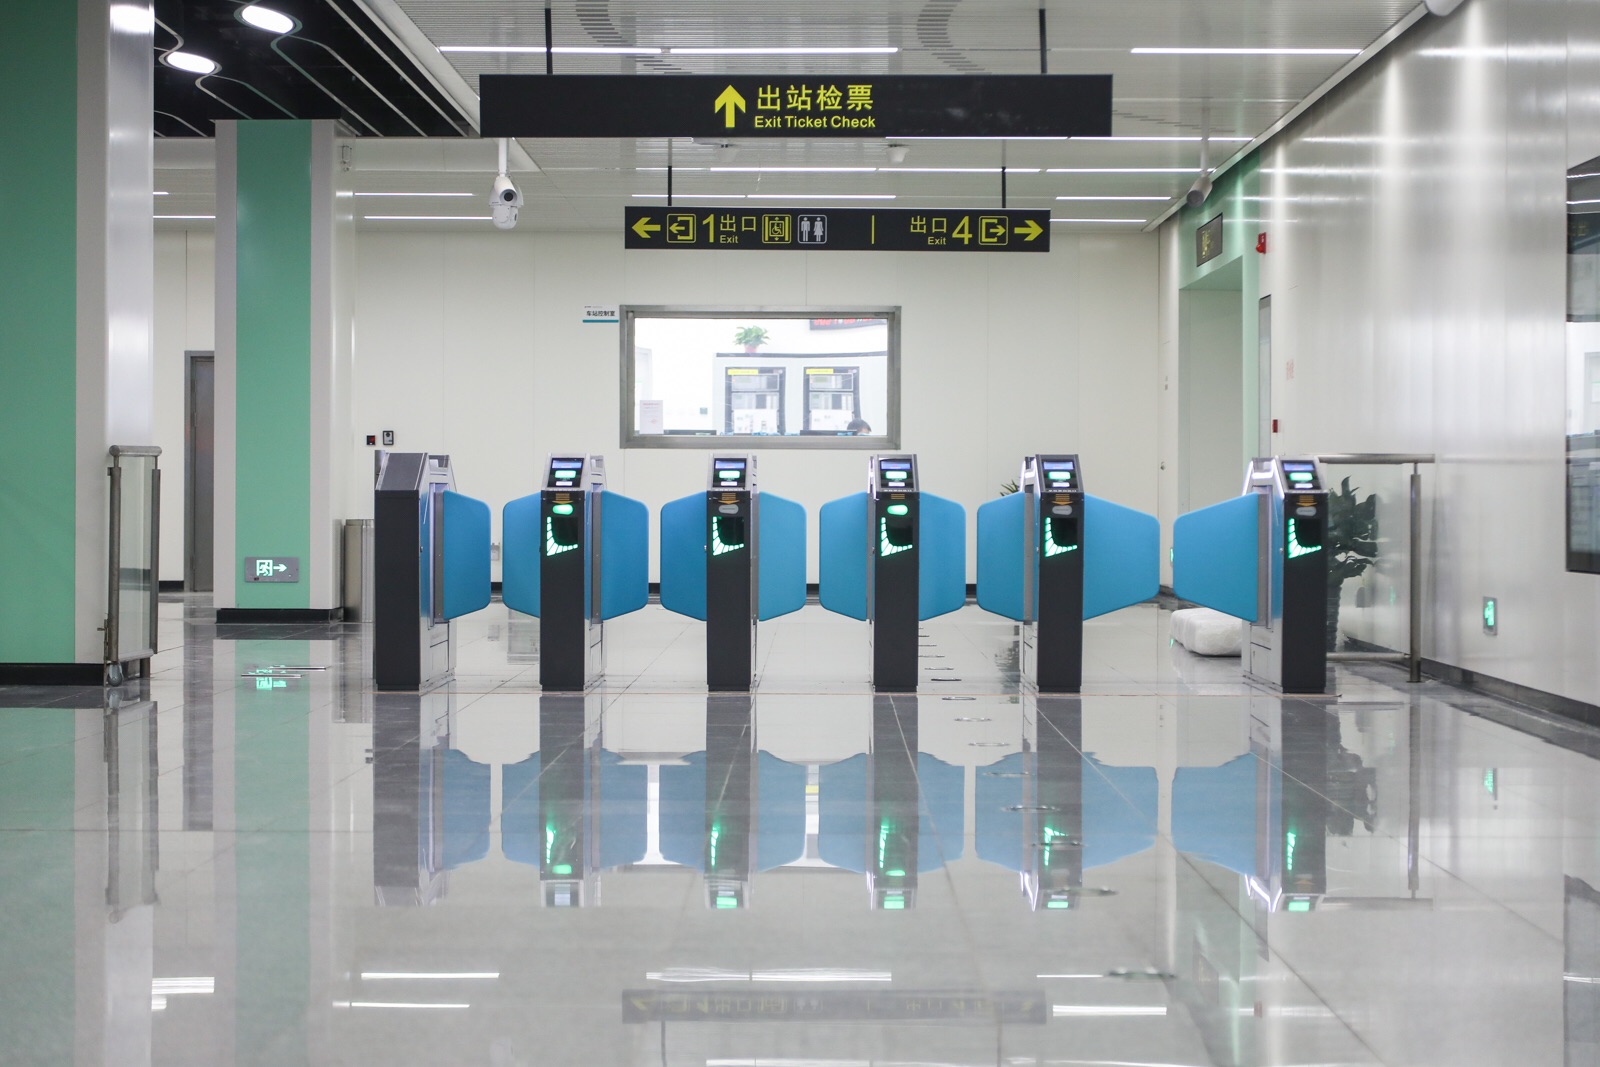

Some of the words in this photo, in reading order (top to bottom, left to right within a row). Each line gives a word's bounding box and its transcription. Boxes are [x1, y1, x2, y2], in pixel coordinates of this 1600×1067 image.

[757, 84, 873, 111] 出站检票
[755, 116, 781, 128] Exit
[784, 116, 827, 128] Ticket
[830, 116, 875, 128] Check
[702, 214, 715, 243] 1
[720, 214, 757, 233] 出口
[910, 215, 947, 233] 出口
[952, 216, 973, 245] 4
[720, 235, 739, 244] Exit
[928, 237, 947, 246] Exit
